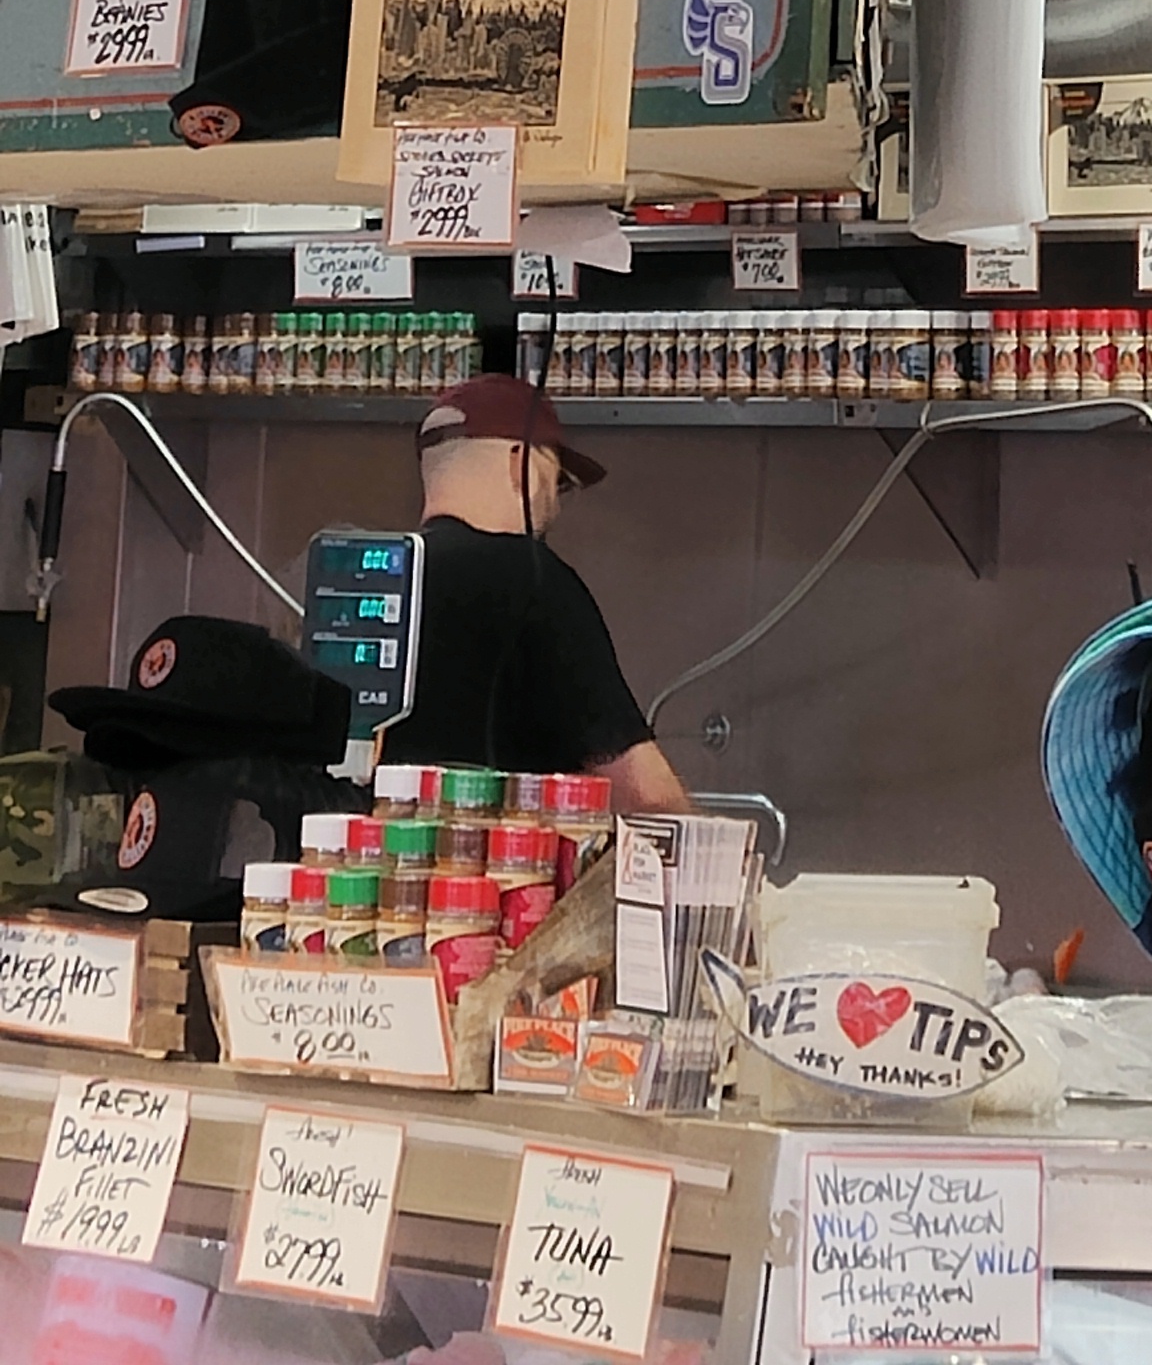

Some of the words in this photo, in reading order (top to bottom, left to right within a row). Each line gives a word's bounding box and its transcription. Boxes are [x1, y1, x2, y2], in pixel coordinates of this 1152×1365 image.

[60, 955, 119, 998] HATS
[241, 997, 396, 1030] SEASONINGS
[749, 987, 817, 1039] WE
[795, 1047, 844, 1075] HEY
[79, 1077, 170, 1120] FRESH
[55, 1114, 178, 1173] BRANZINI
[929, 1174, 999, 1206] SELL
[888, 1197, 1004, 1240] SALMON
[526, 1222, 624, 1277] TUNA
[812, 1242, 934, 1273] CAUGHT
[931, 1243, 973, 1280] BY
